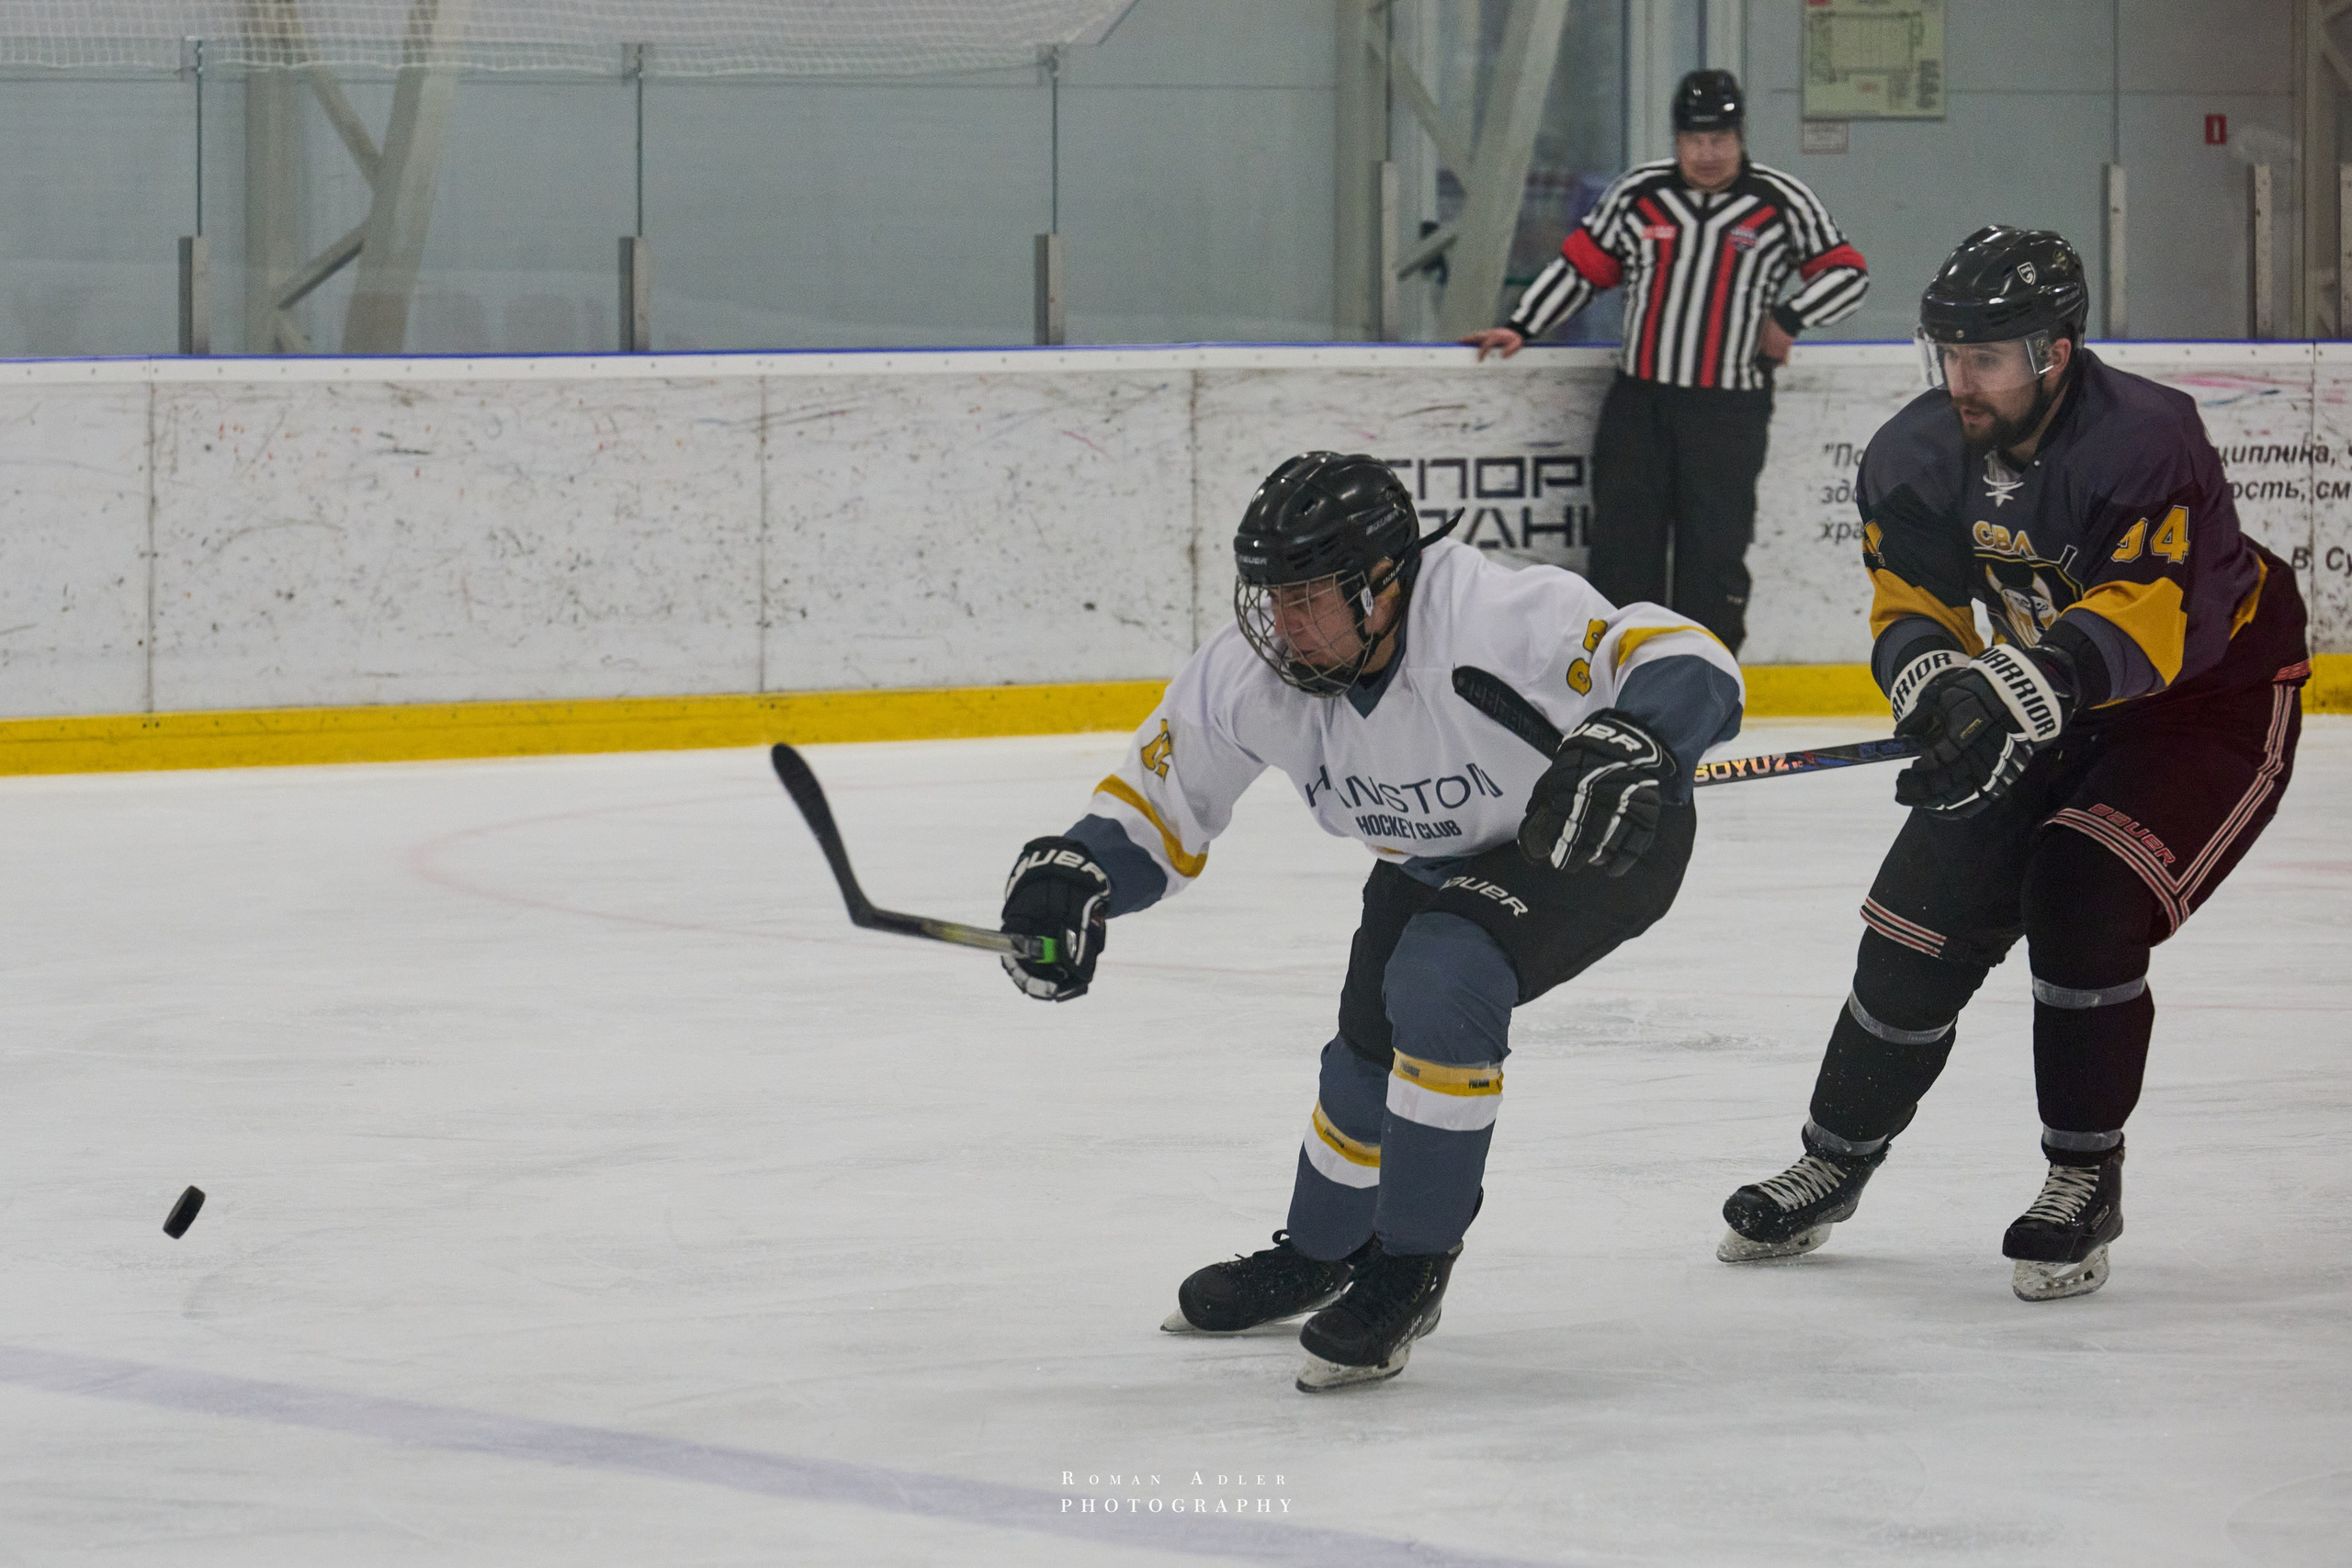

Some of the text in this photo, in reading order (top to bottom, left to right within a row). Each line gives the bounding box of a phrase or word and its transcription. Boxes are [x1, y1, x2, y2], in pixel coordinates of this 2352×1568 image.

[1821, 479, 1858, 504] зд
[1355, 814, 1463, 840] HOCKEY CLUB
[2087, 803, 2177, 867] BAUER
